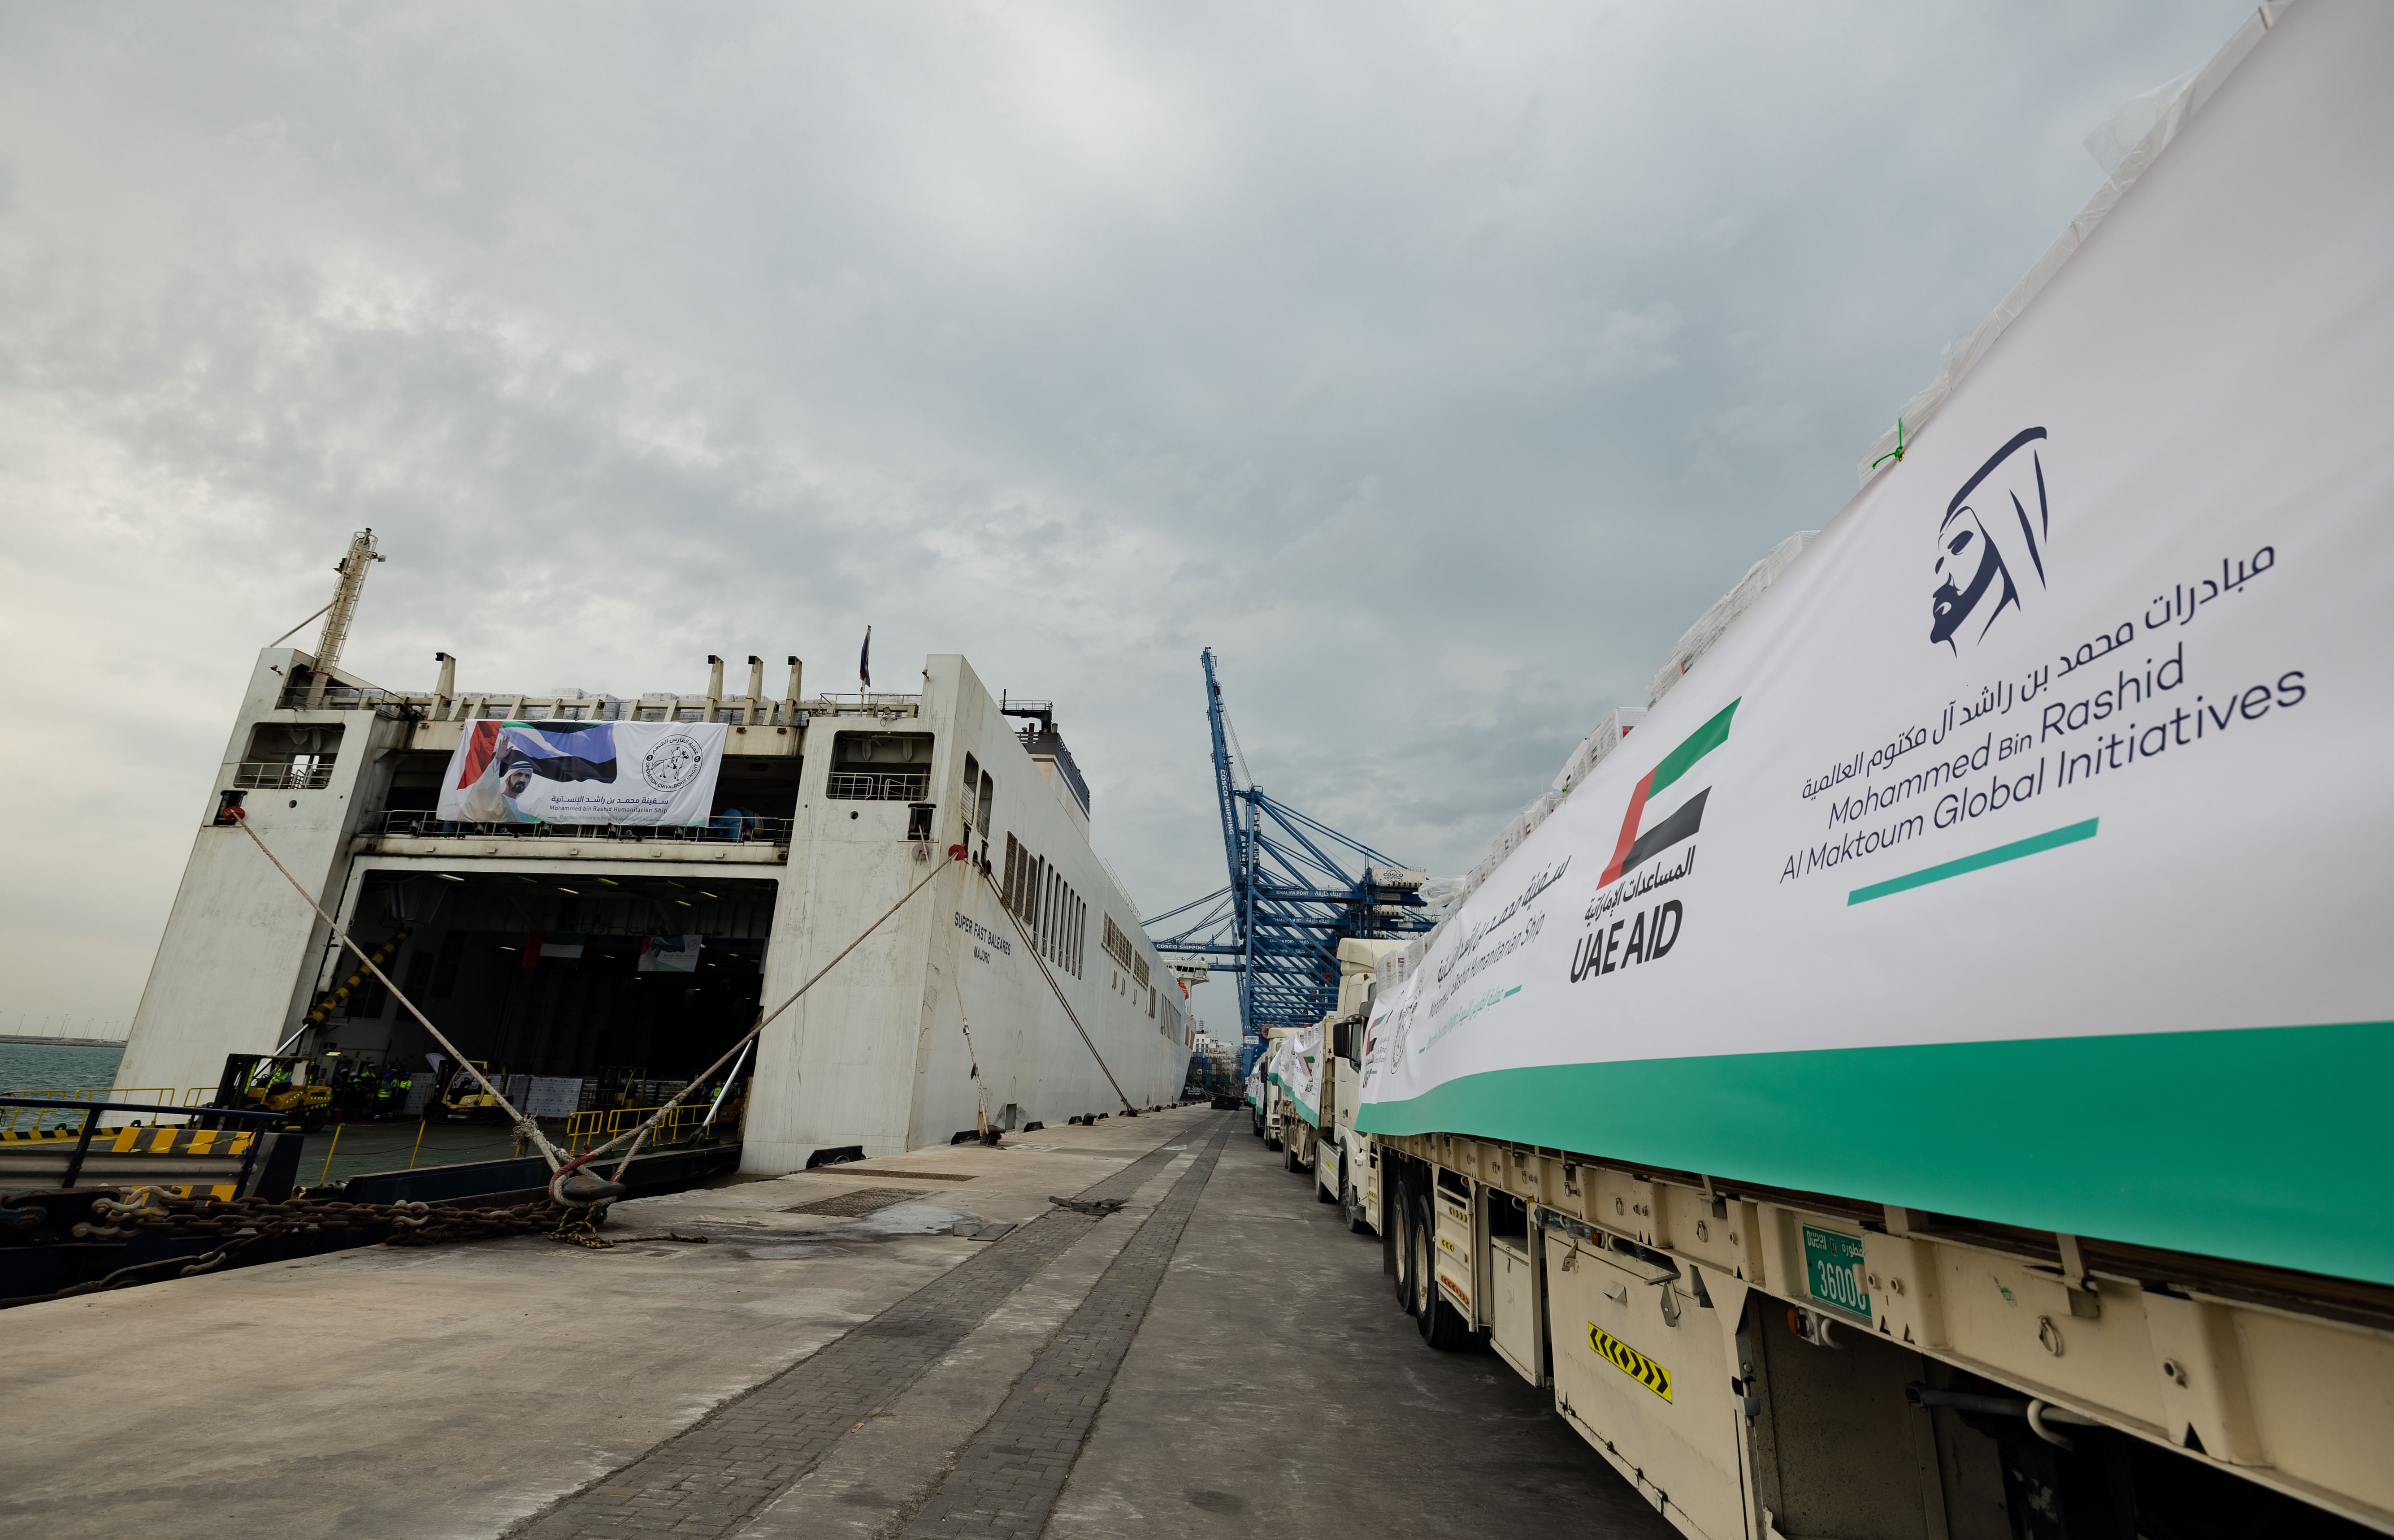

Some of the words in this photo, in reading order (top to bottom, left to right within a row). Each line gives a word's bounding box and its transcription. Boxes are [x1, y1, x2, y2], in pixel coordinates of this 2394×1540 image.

[2145, 545, 2275, 630] مبادرات
[2057, 622, 2134, 678] محمد
[1960, 680, 2013, 726] راشد
[2021, 665, 2048, 702] بن
[1829, 732, 1992, 830] Mohammed
[1998, 733, 2032, 761] Bin
[2041, 641, 2184, 743] Rashid
[1933, 700, 1956, 745] آل
[1867, 726, 1927, 778] مكتوم
[646, 762, 658, 786] OPERATION
[657, 779, 687, 789] CHIVALROUS
[686, 763, 698, 780] KNIGHT
[1780, 850, 1803, 884] Al
[1807, 815, 1923, 874] Maktoum
[1934, 757, 2045, 829] Global
[2058, 671, 2307, 787] Initiatives
[1802, 751, 1864, 802] العالمية
[551, 795, 584, 805] الإنسانية
[585, 795, 605, 805] راشد
[642, 796, 668, 805] سفينة
[1220, 769, 1228, 796] COSCO
[1224, 799, 1234, 835] SHIPPING
[1622, 845, 1696, 903] المساعدات
[954, 911, 972, 935] SUPER
[974, 922, 987, 943] FAST
[988, 931, 1011, 956] BALEARES
[1521, 910, 1545, 946] Ship
[1570, 919, 1625, 983] UAE
[1620, 900, 1683, 969] AID
[973, 946, 990, 964] MAJURO
